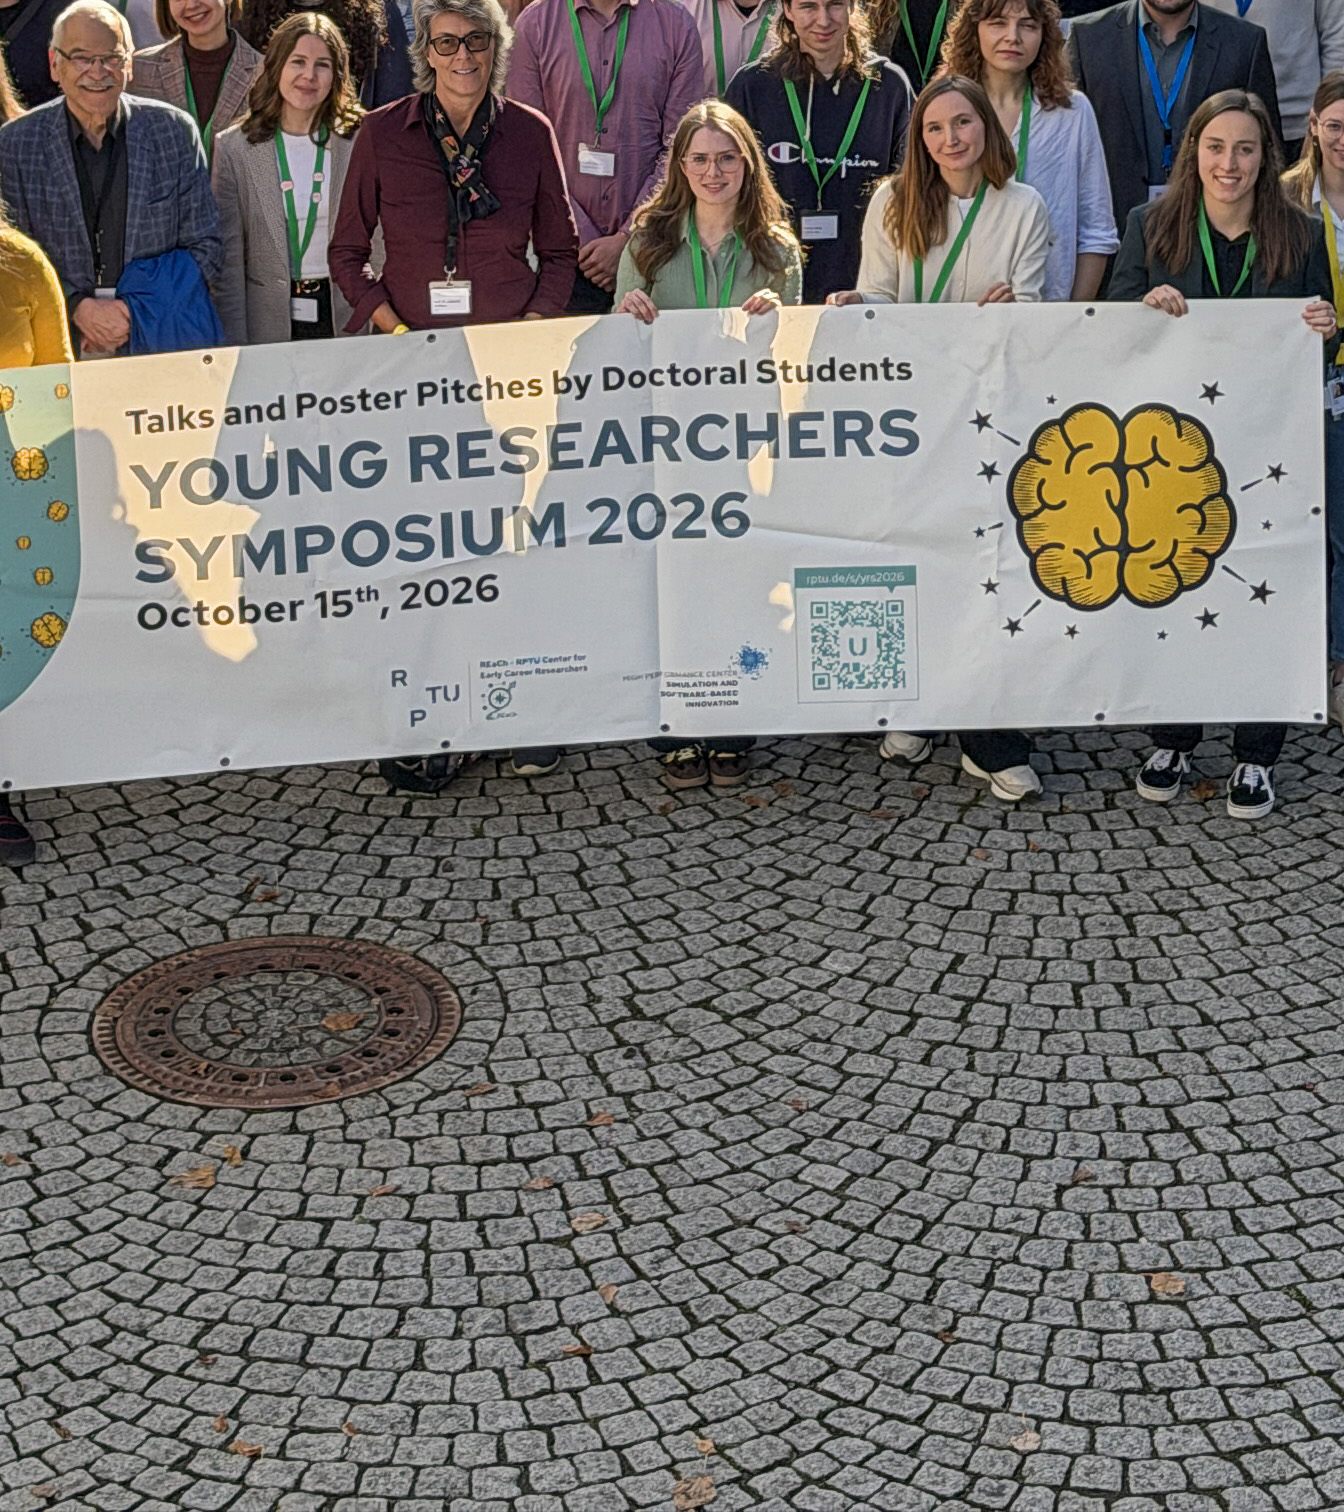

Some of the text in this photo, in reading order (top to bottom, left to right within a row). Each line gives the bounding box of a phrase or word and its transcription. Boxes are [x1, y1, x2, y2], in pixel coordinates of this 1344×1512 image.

[767, 141, 880, 178] Chmpion
[126, 356, 913, 435] Talks and Poster Pitches by Doctoral Students
[129, 409, 920, 509] YOUNG RESEARCHERS
[134, 491, 751, 583] SYMPOSIUM 2026
[806, 572, 905, 584] rptu.de/s/yrs2026
[137, 574, 500, 630] October 15th, 2026
[848, 637, 867, 656] U
[516, 656, 541, 666] RPTU
[542, 654, 572, 664] Center
[573, 653, 587, 661] for
[391, 669, 408, 687] R
[480, 665, 588, 679] Early Career Researchers
[666, 679, 739, 688] SIMULATION AND
[425, 684, 460, 704] TU
[685, 699, 739, 708] INNOVATION
[410, 709, 426, 728] P
